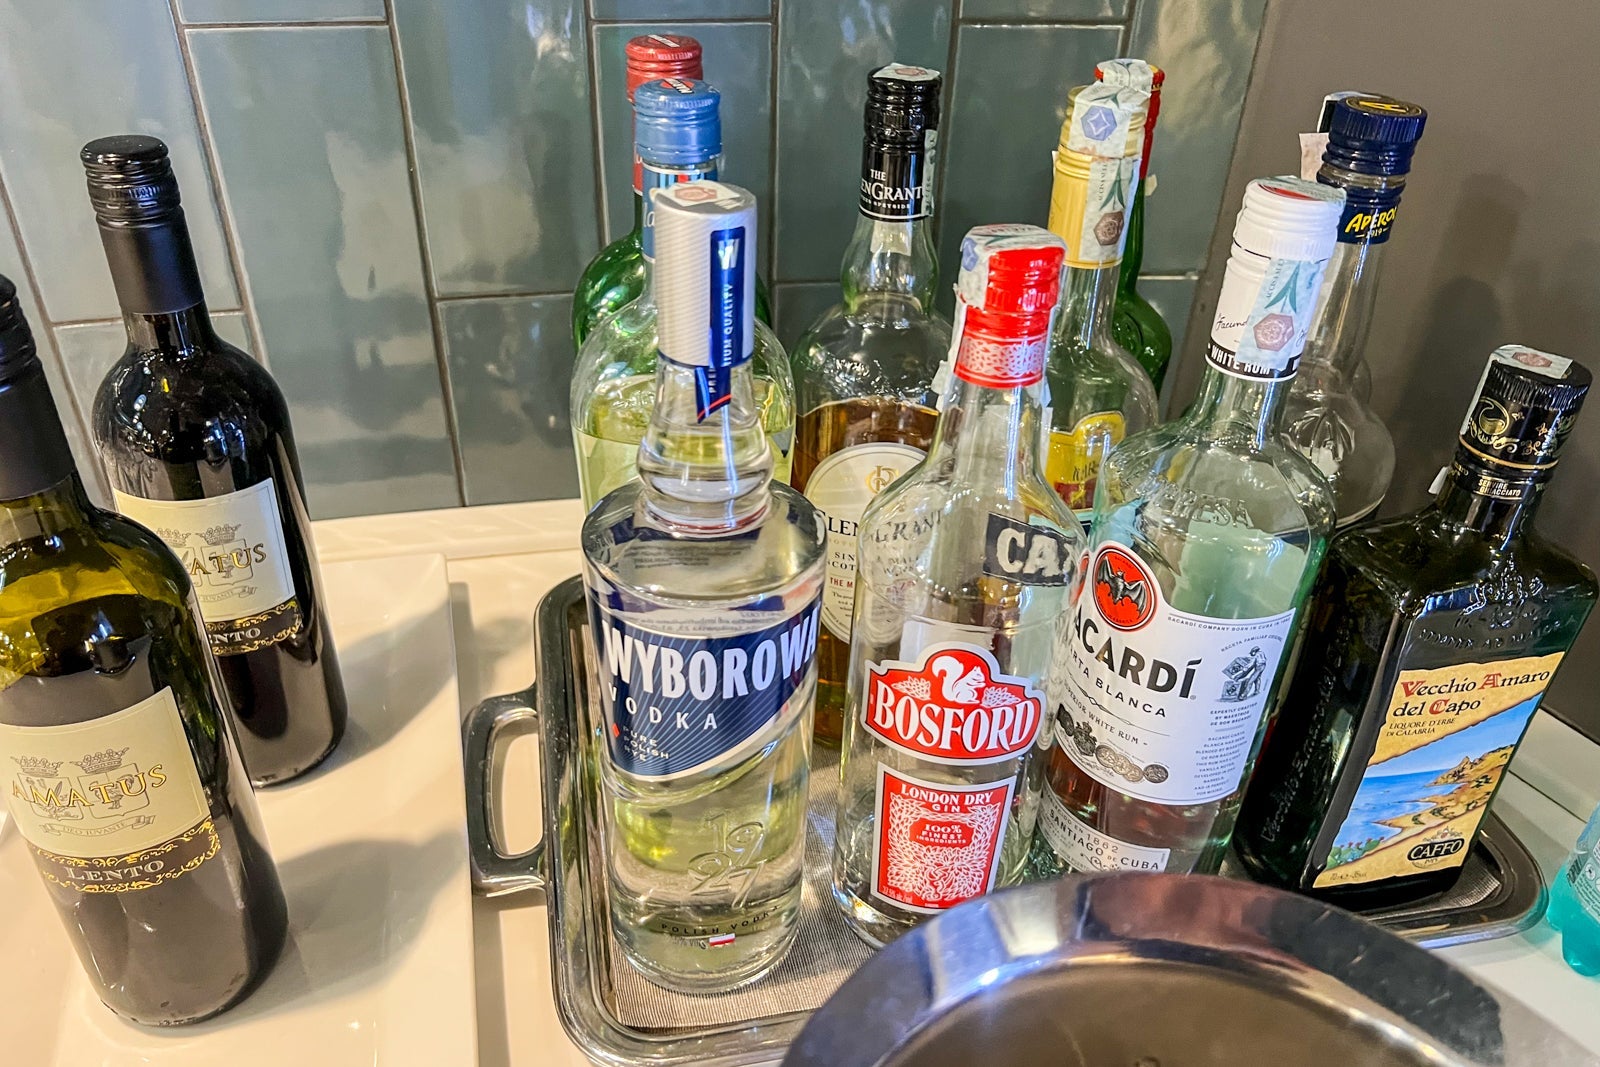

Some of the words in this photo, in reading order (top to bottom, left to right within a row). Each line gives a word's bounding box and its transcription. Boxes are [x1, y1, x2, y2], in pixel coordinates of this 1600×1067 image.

[870, 169, 887, 181] THE
[723, 284, 734, 335] QUALITY
[1211, 344, 1240, 370] WHITE
[829, 577, 844, 587] THE
[1198, 623, 1230, 632] COMPANY
[602, 604, 820, 702] WYBOROWA
[1400, 677, 1477, 698] Vecchio
[1477, 670, 1550, 691] Amaro
[608, 681, 718, 730] VODKA
[1095, 676, 1167, 718] BLANCA
[1392, 701, 1426, 717] del
[1428, 698, 1482, 717] Capo
[873, 679, 1036, 753] BOSFORD
[1389, 720, 1426, 730] LIQUORE
[1088, 711, 1115, 733] WHITE
[1117, 730, 1139, 745] RUM
[1395, 727, 1436, 737] CALABRIA
[11, 763, 168, 808] AMATUS
[901, 783, 960, 805] LONDON
[963, 791, 994, 806] DRY
[931, 804, 961, 813] GIN
[916, 835, 967, 844] INGREDIENTS
[921, 830, 963, 840] FINEST
[925, 823, 963, 834] 100%
[1049, 809, 1104, 856] SANTIAGO
[1120, 856, 1160, 870] CUBA
[1086, 833, 1119, 854] 1862
[1410, 839, 1463, 860] CAFFO
[64, 859, 166, 882] LENTO
[661, 923, 720, 935] POLISH
[730, 905, 779, 931] VODKA
